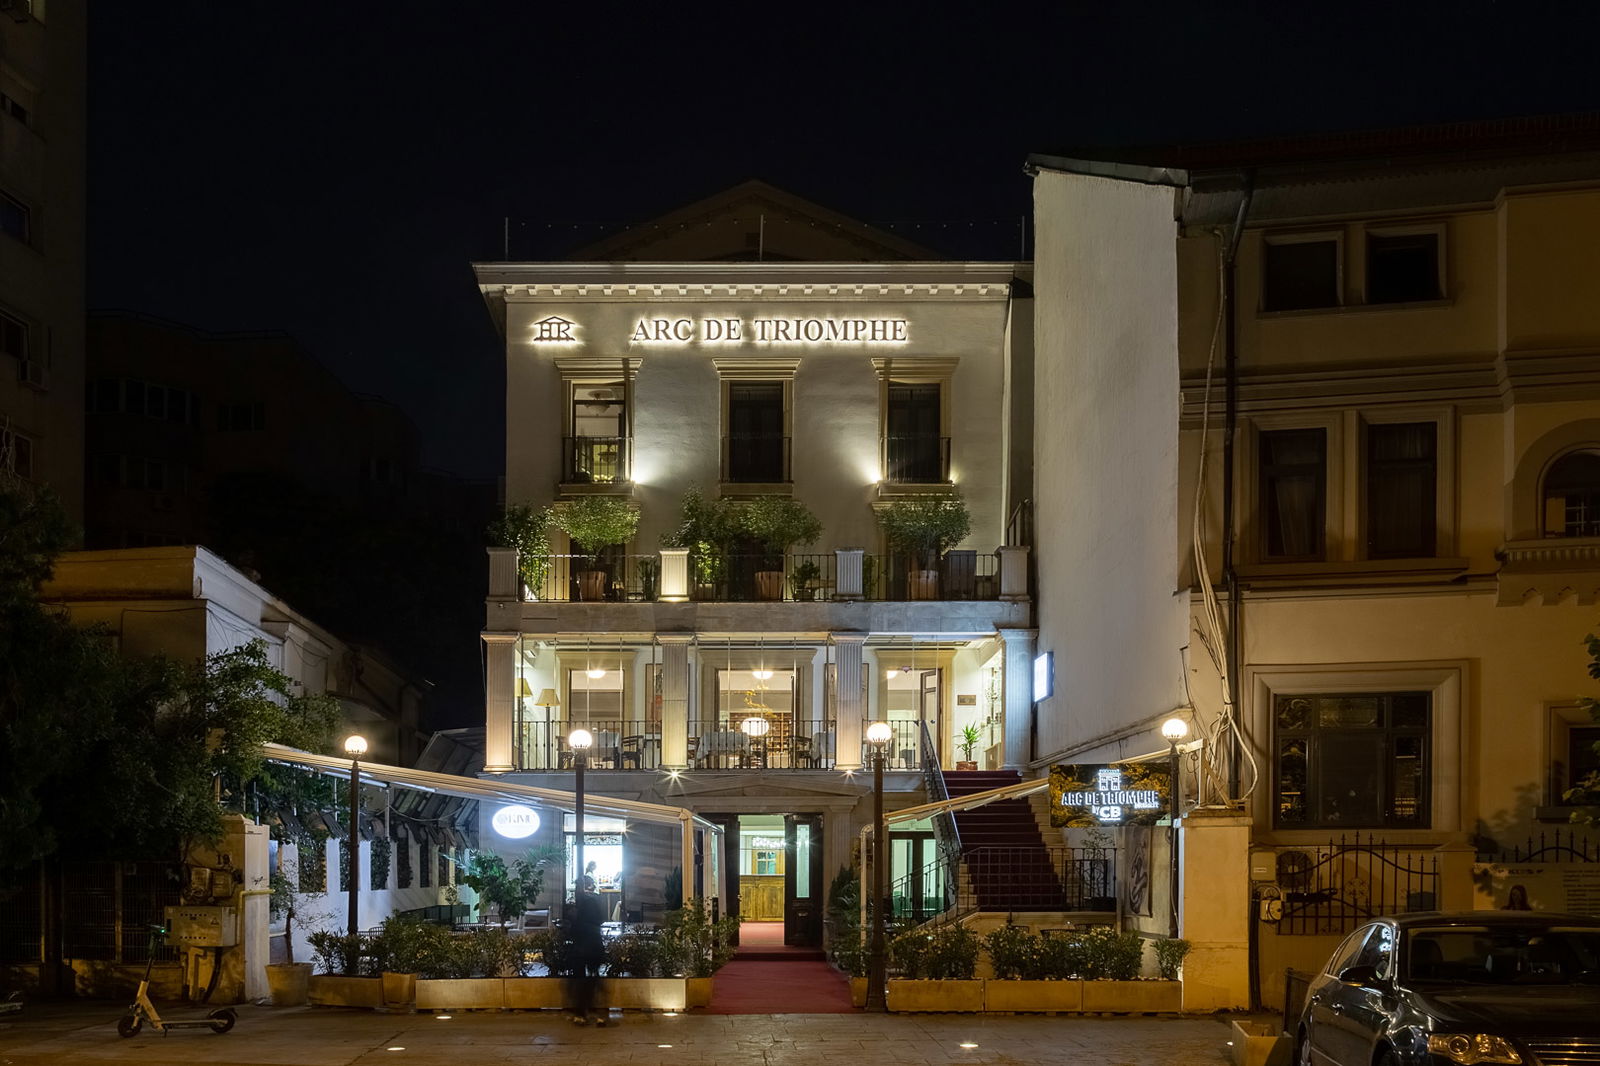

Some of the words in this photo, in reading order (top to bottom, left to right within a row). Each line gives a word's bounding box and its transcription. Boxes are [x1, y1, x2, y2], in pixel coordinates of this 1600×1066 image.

[632, 318, 693, 342] ARC
[704, 318, 742, 342] DE
[754, 318, 908, 342] TRIOMPHE
[1061, 792, 1083, 806] ARC
[1085, 792, 1100, 806] DE
[1100, 790, 1159, 805] TRIOMPHE
[1099, 805, 1122, 818] CB
